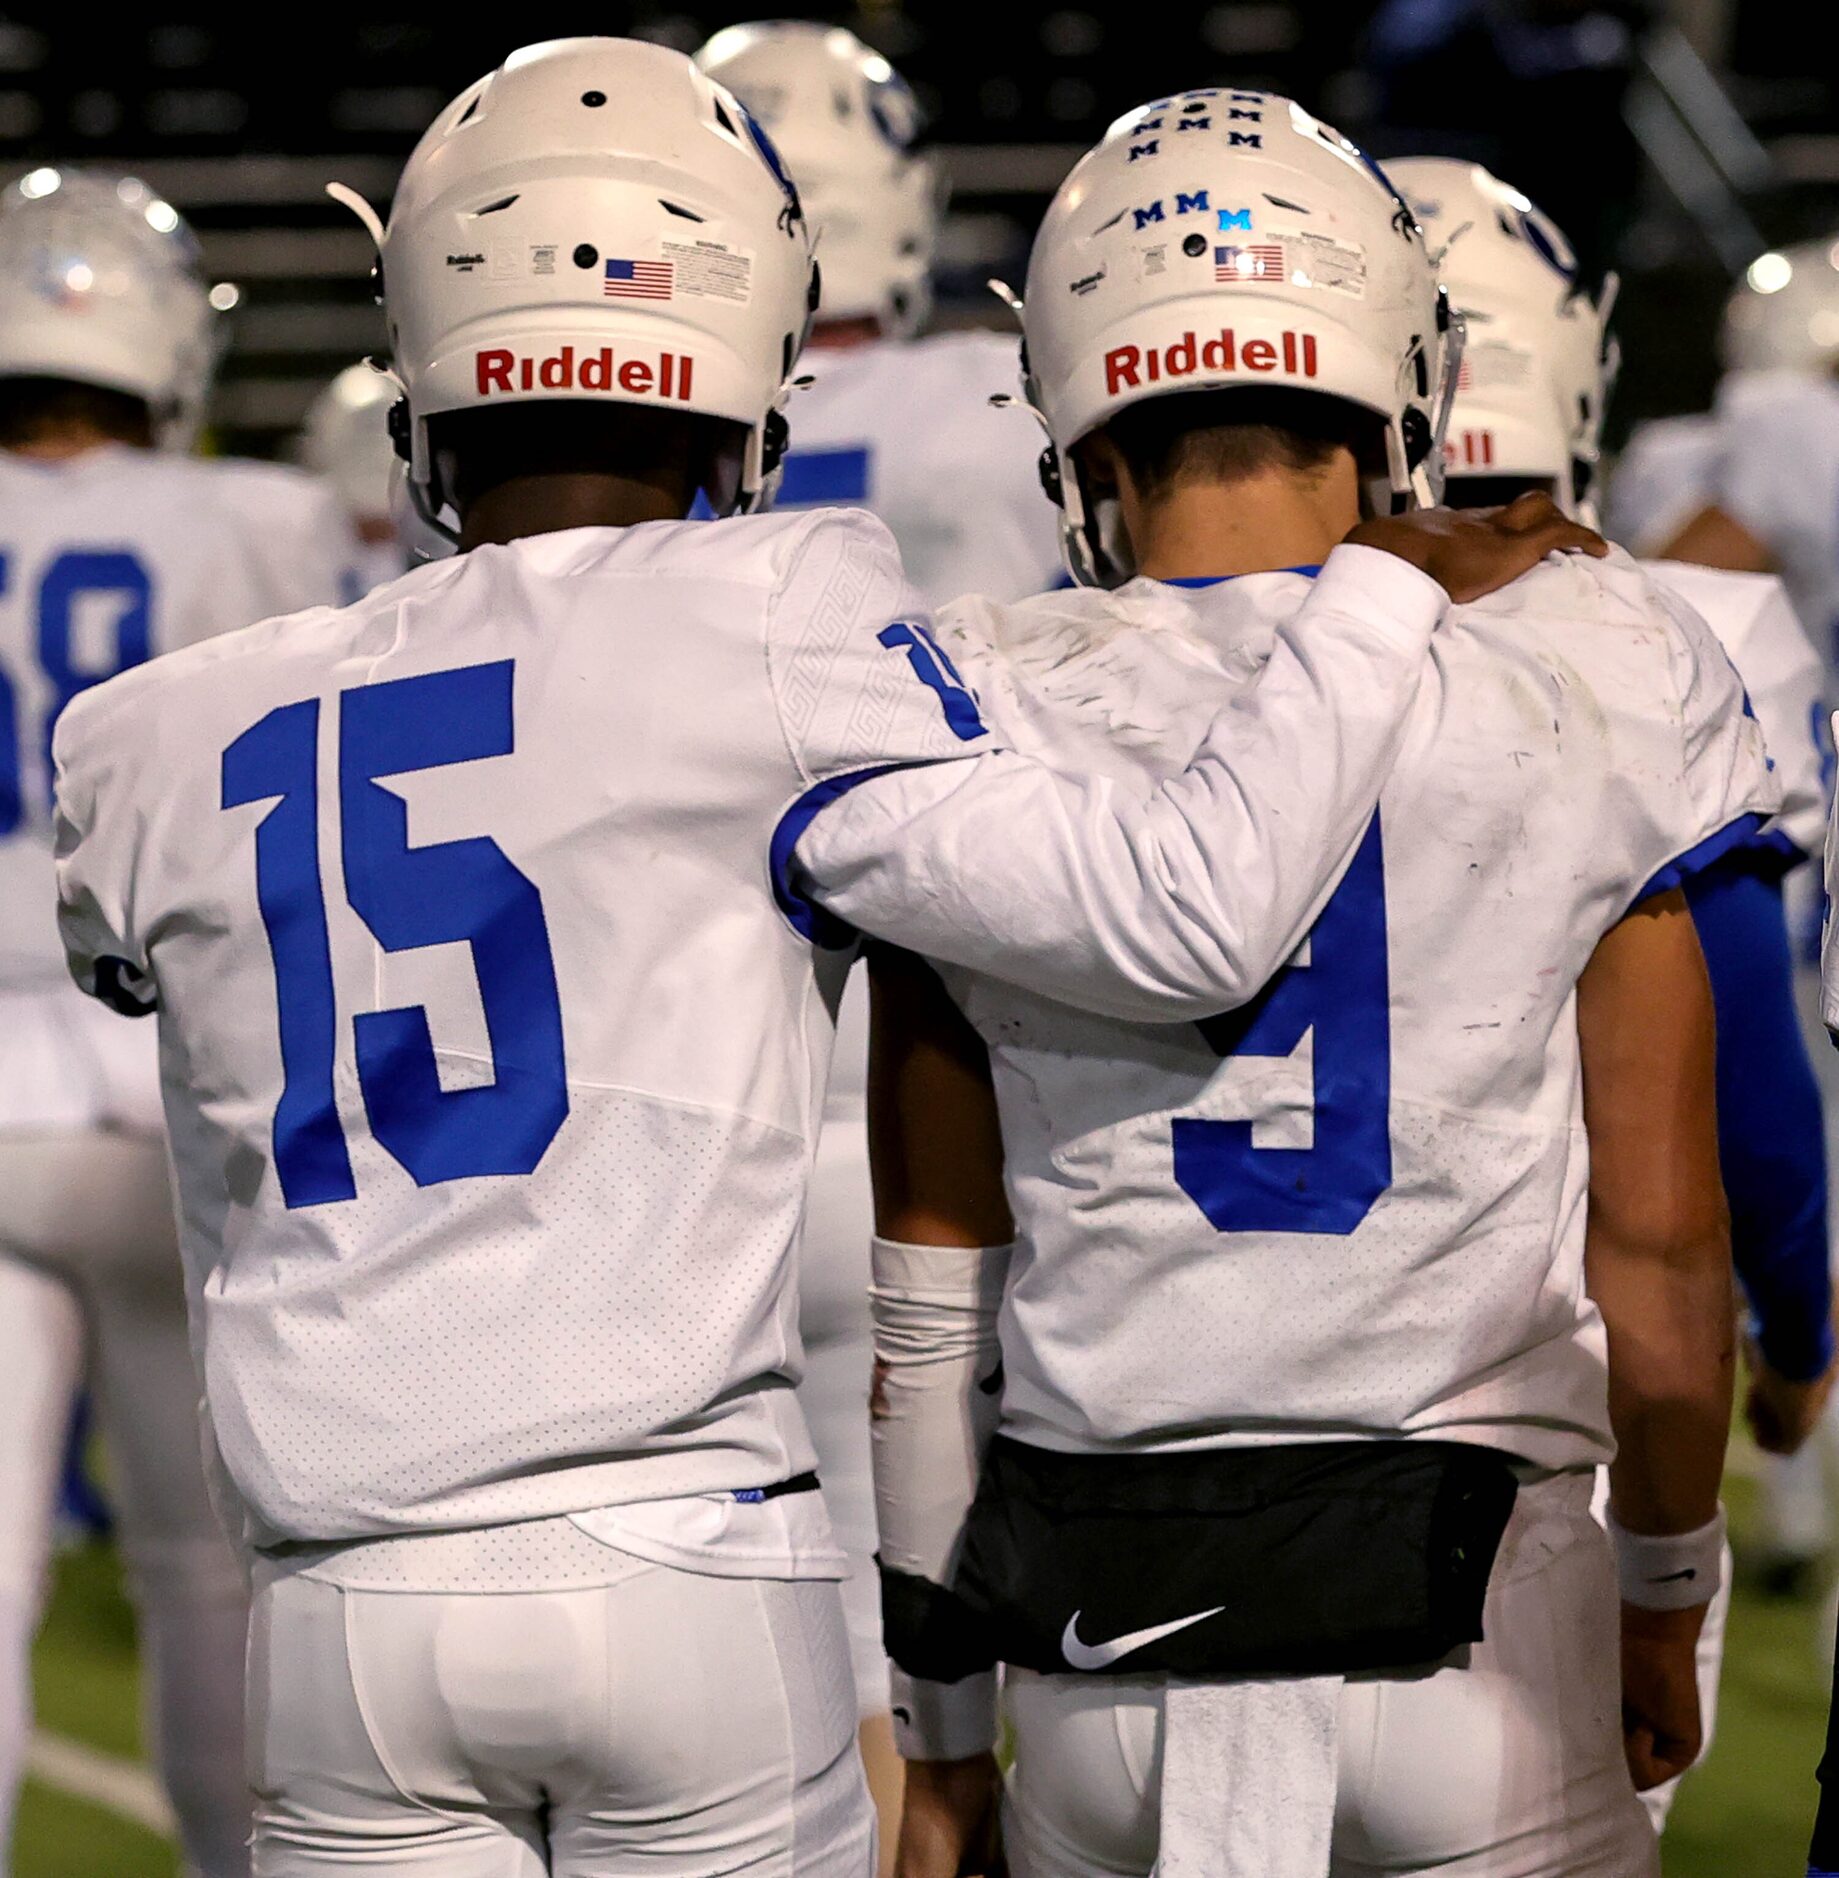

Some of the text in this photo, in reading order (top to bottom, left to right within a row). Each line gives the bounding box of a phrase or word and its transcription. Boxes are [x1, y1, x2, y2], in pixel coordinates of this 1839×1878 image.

[1178, 116, 1211, 131] M
[1128, 140, 1160, 163] M
[1228, 131, 1262, 149] M
[1132, 200, 1166, 230] M
[1175, 189, 1210, 215] M
[1217, 208, 1252, 230] M
[477, 346, 693, 401] Riddell
[1106, 328, 1318, 396] Riddell
[221, 658, 570, 1209] 15
[1172, 799, 1393, 1236] 9
